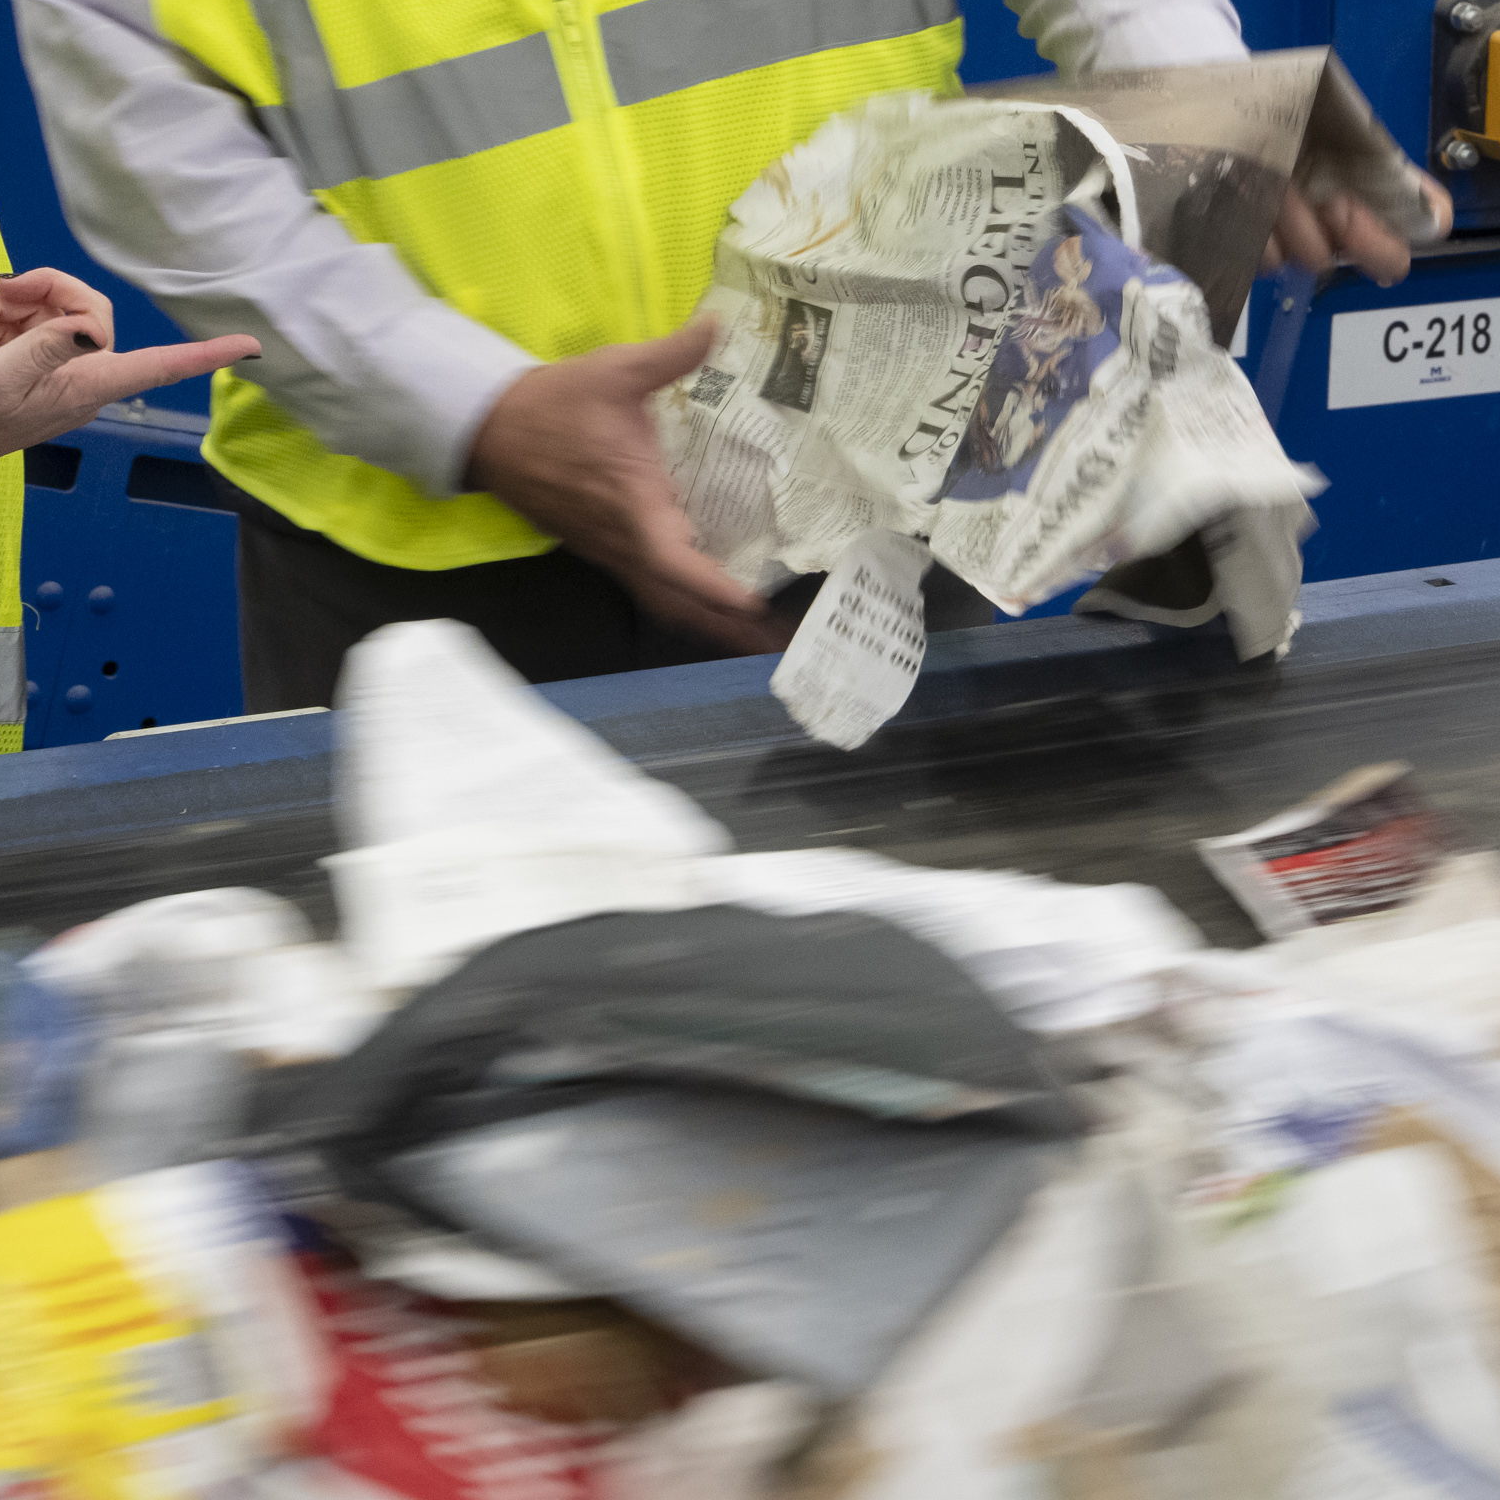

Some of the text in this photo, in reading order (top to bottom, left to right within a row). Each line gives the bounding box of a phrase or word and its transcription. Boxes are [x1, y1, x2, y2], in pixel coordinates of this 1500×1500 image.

[1022, 142, 1043, 175] IN
[897, 168, 1026, 462] LEGEND
[1383, 312, 1491, 363] C-218
